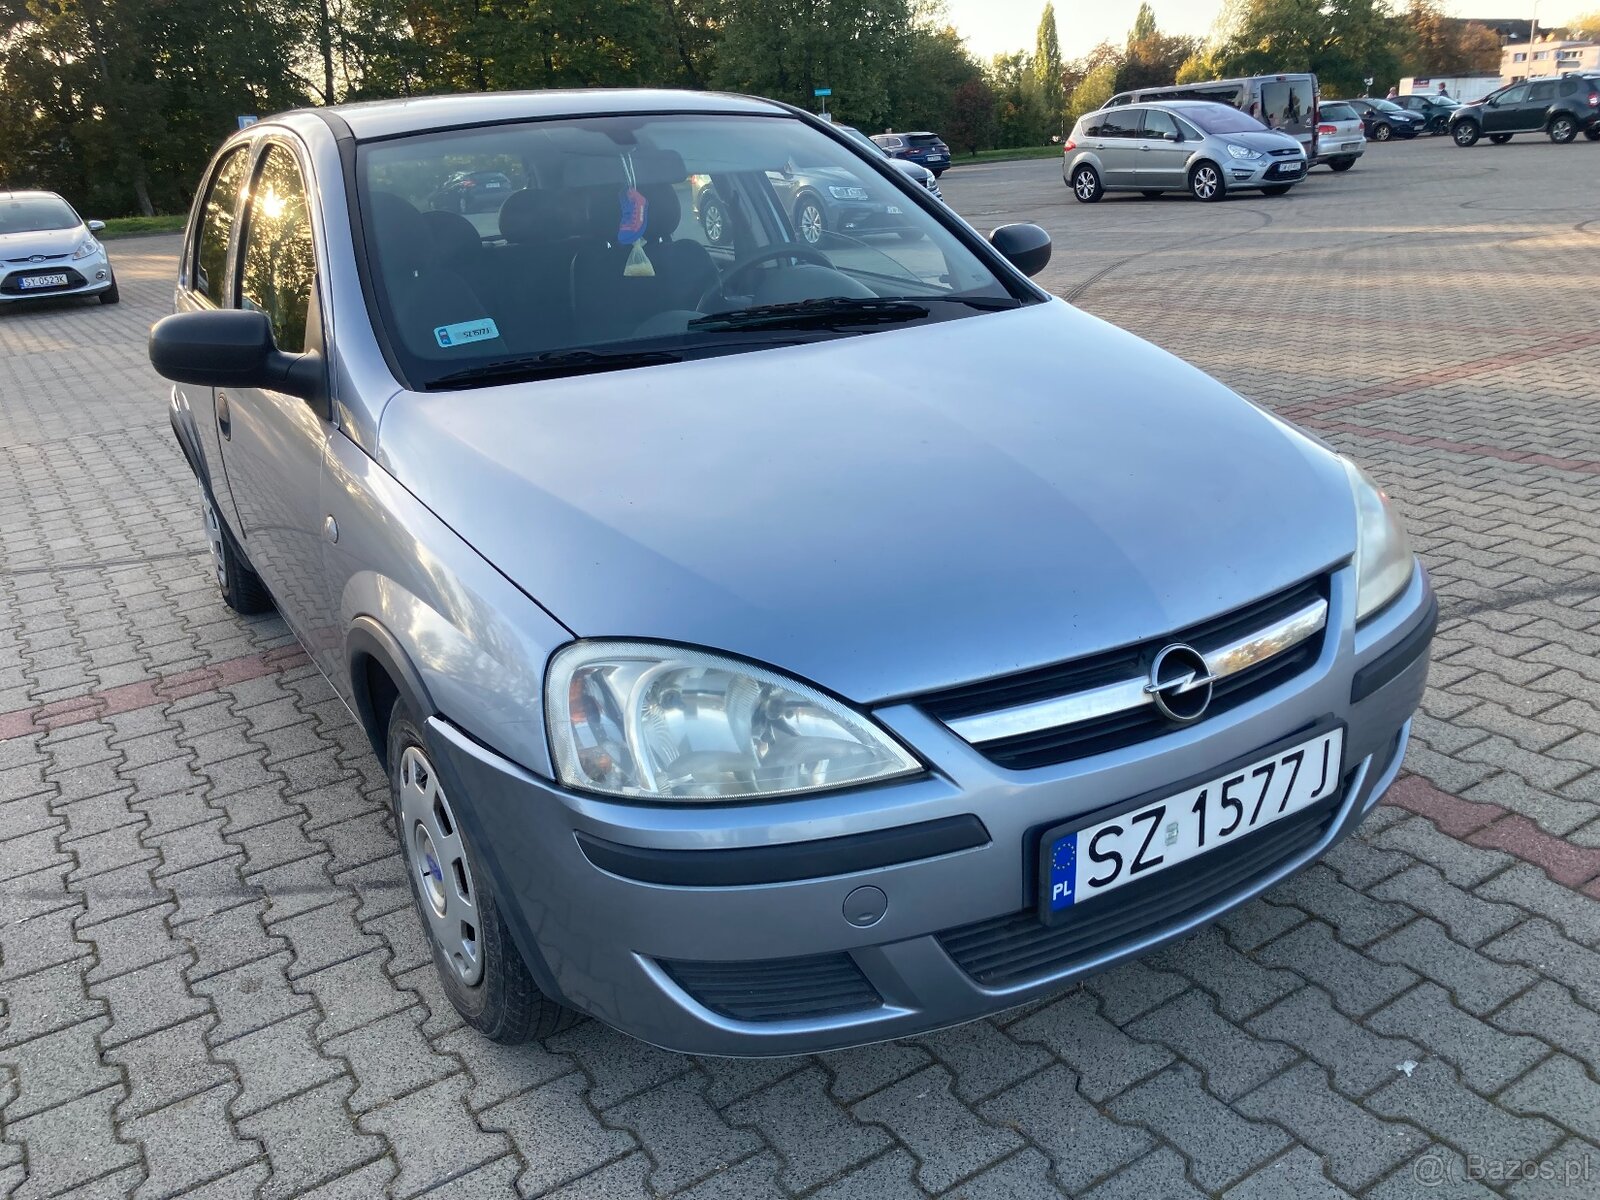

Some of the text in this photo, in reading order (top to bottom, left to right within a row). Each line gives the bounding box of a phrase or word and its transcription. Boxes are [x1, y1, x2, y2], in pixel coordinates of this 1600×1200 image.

[1087, 738, 1331, 888] SZ 1577J
[1052, 880, 1072, 901] PL
